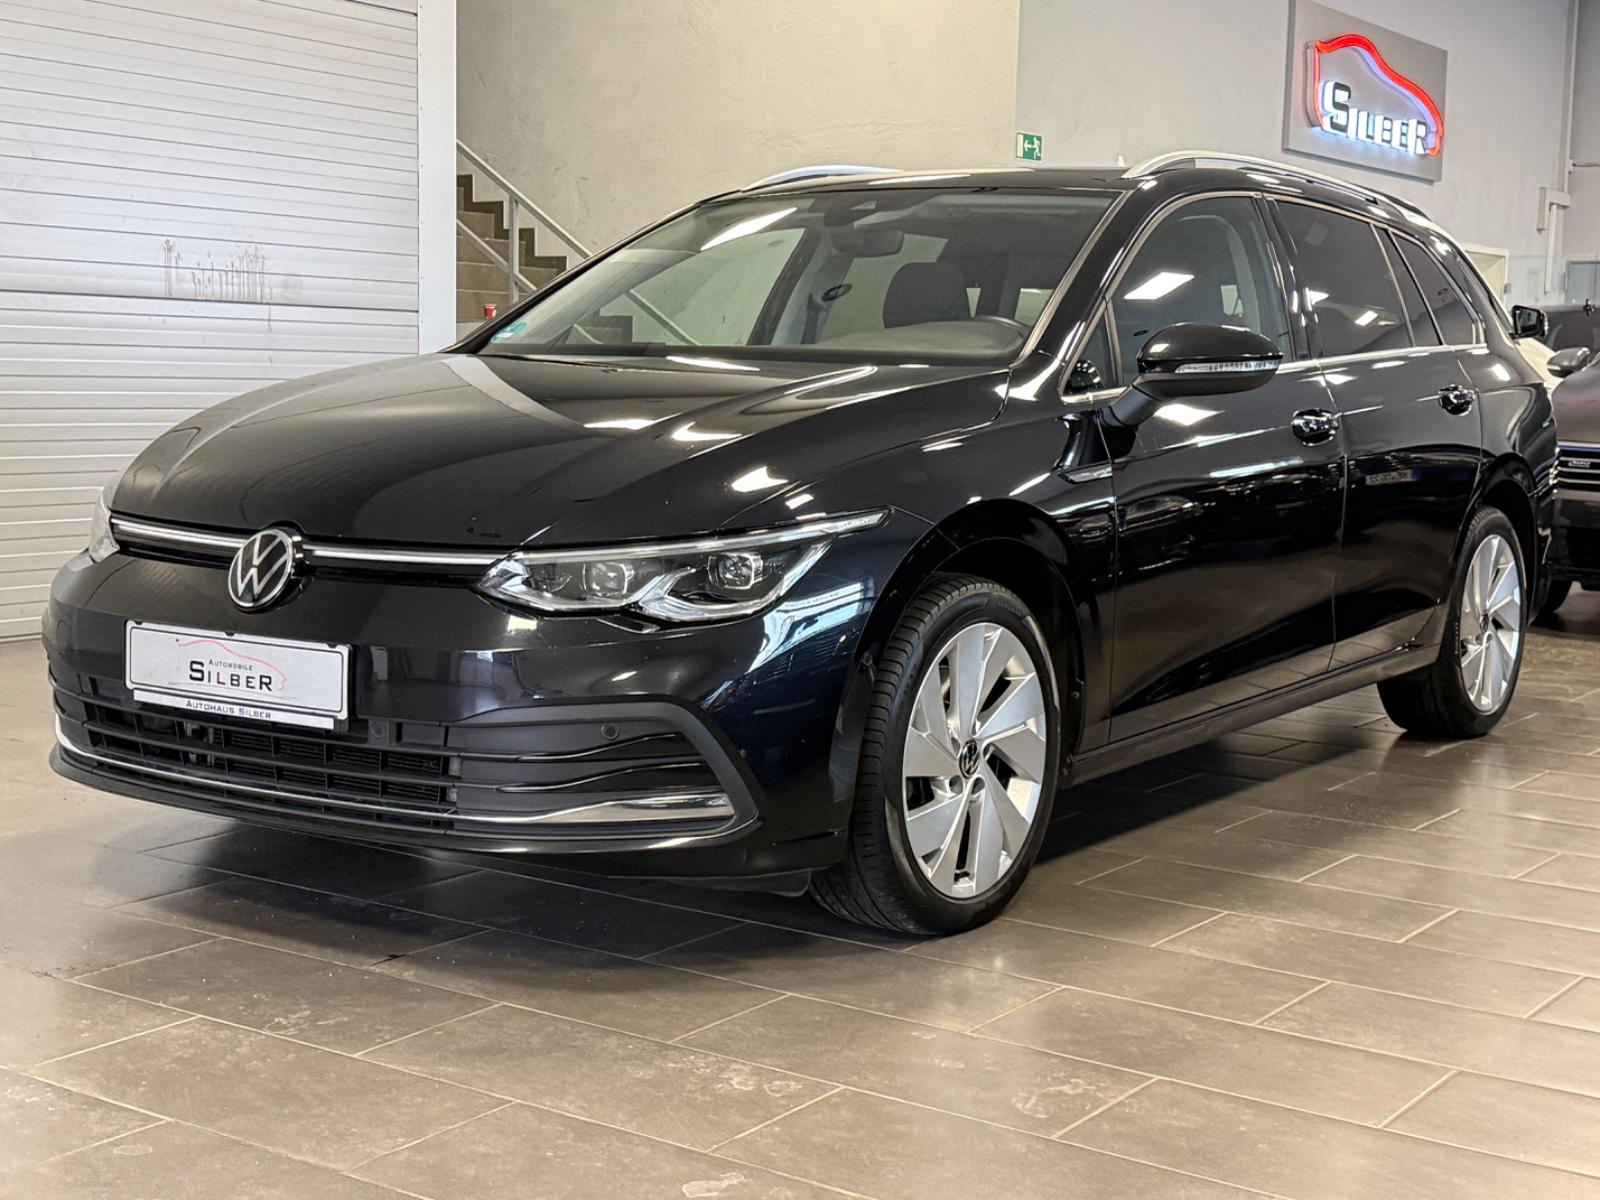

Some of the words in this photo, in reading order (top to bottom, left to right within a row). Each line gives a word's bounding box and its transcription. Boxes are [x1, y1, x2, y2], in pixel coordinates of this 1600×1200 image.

[1322, 81, 1428, 155] SILBER
[189, 661, 272, 691] SILBER
[208, 658, 253, 672] AUTOMOBILE
[186, 701, 235, 714] AUTOHAUS
[238, 706, 271, 719] SILBER
